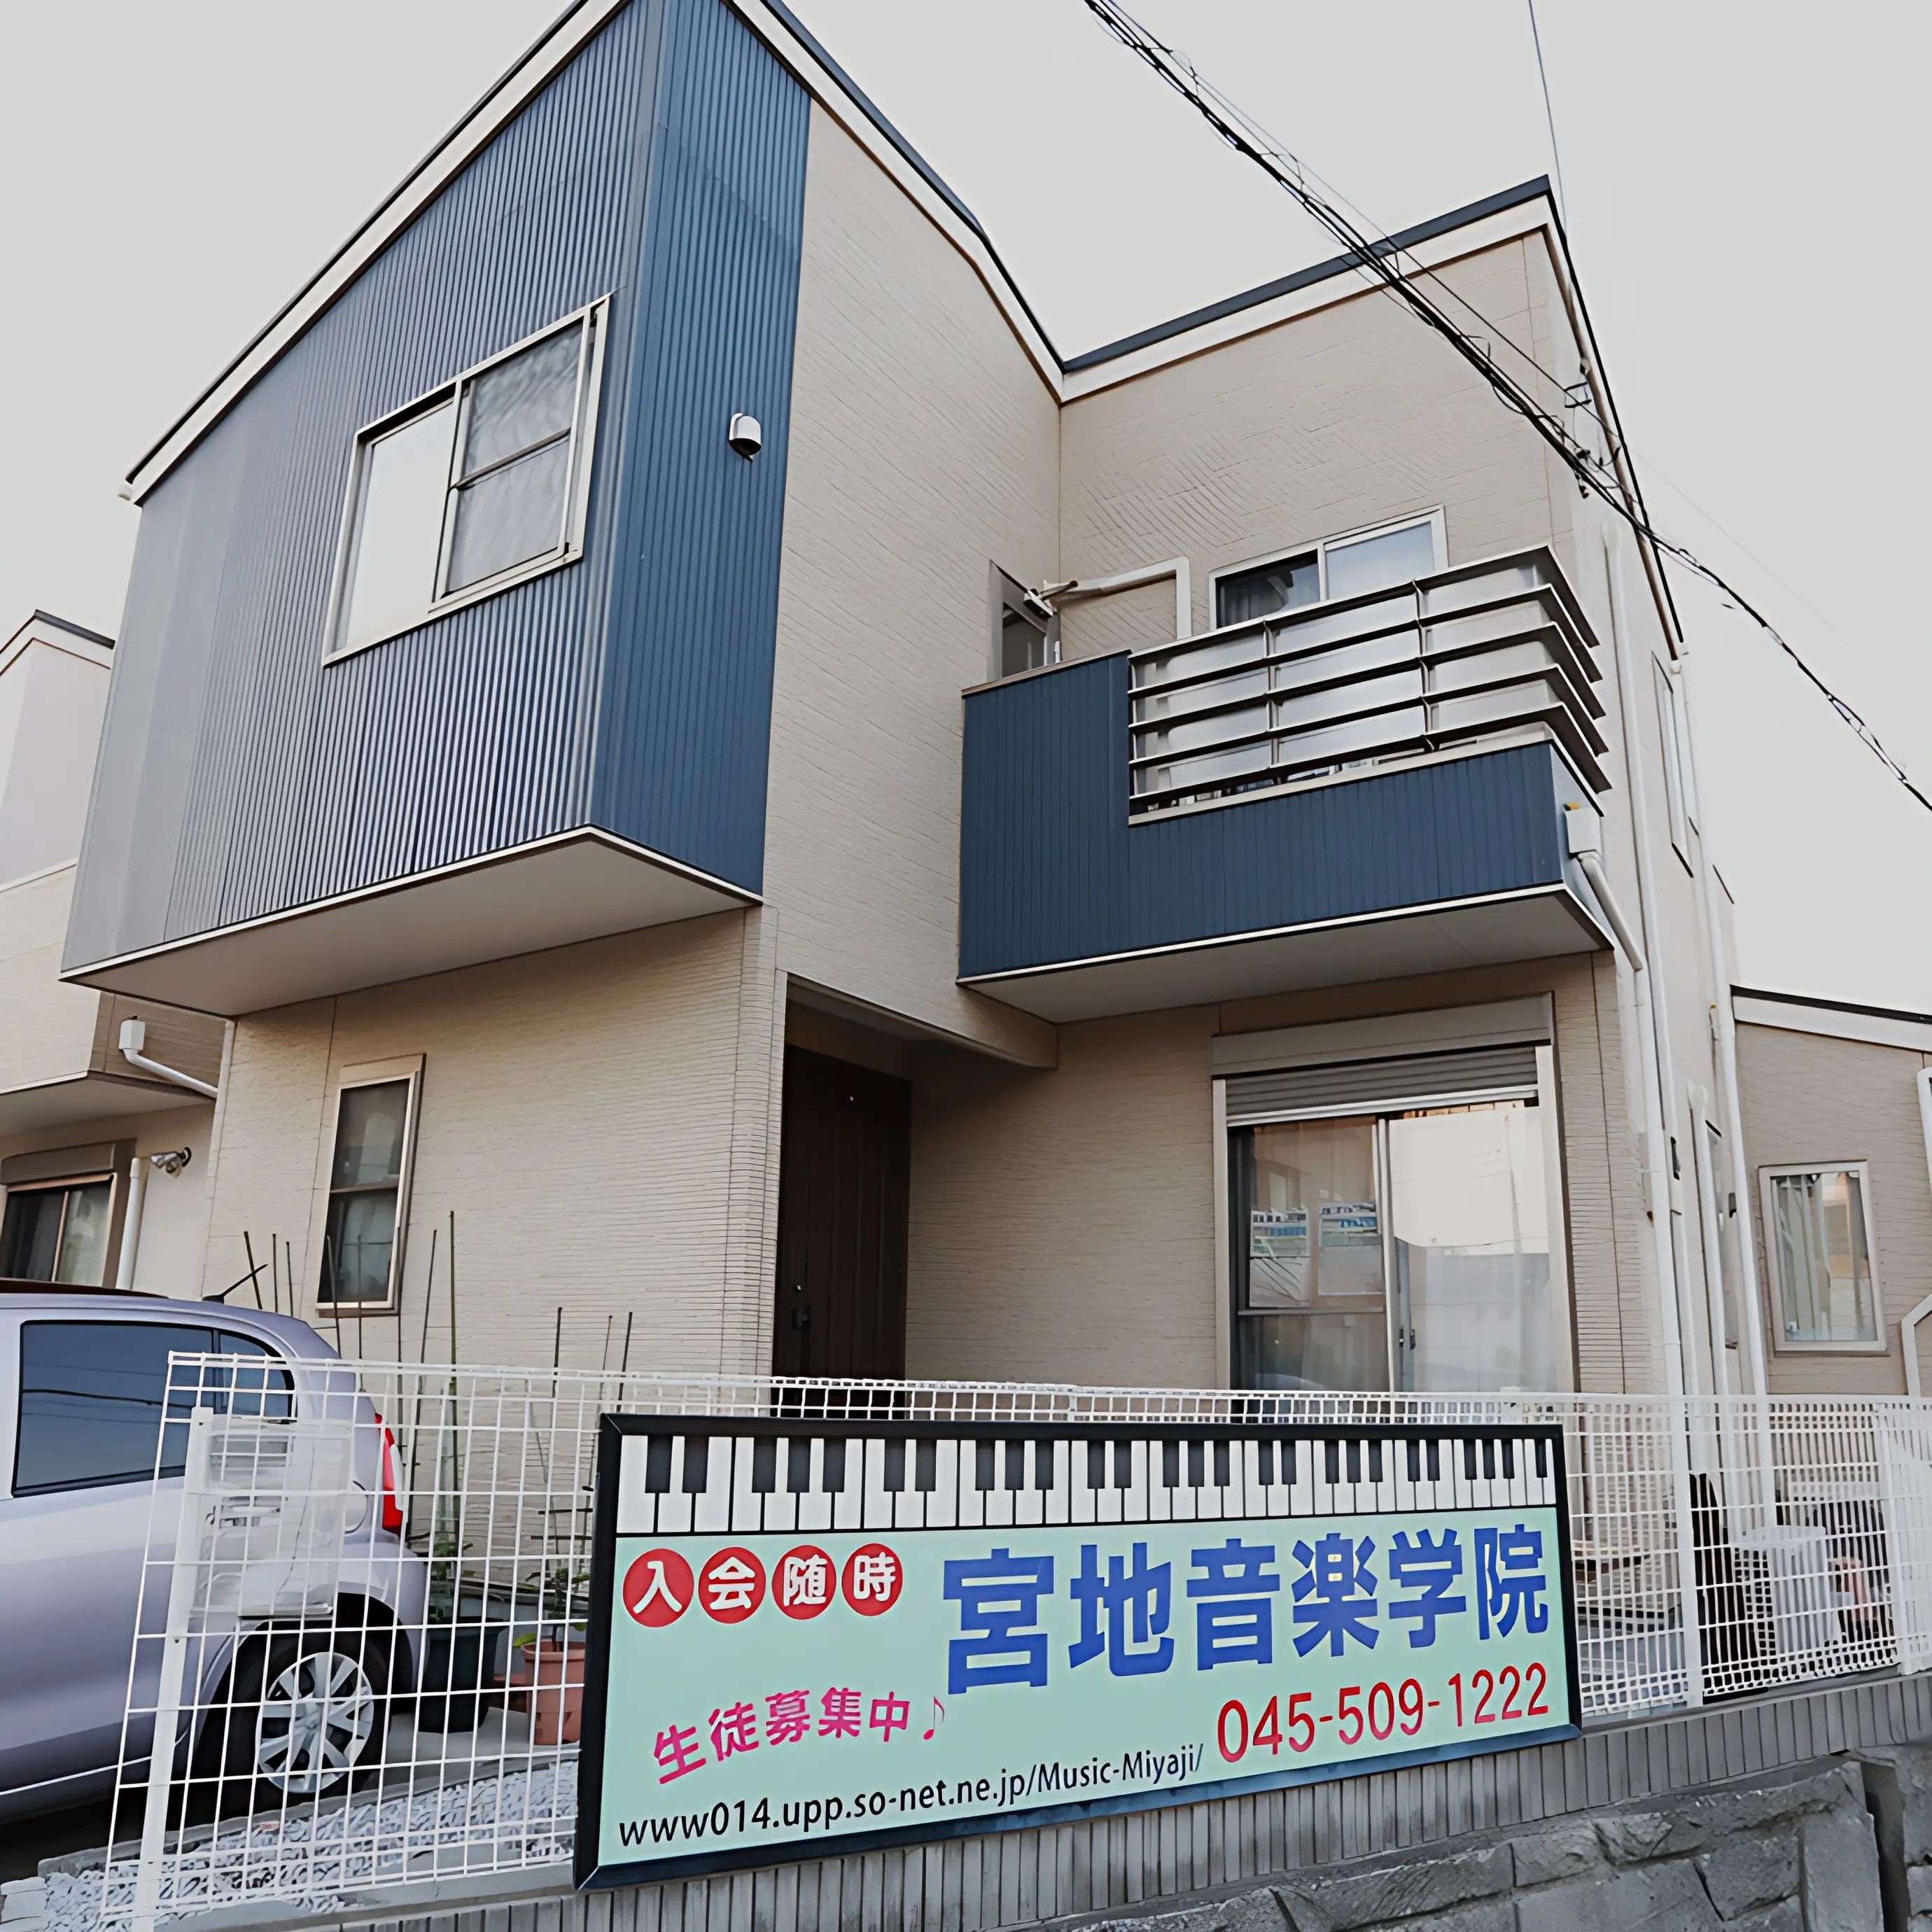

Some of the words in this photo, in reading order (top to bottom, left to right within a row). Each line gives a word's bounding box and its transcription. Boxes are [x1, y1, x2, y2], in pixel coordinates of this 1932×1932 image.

[632, 1551, 897, 1614] 入会随時
[943, 1524, 1548, 1695] 宮地音楽学院
[653, 1687, 910, 1784] 生徒募集中
[1217, 1662, 1549, 1763] 045-509-1222
[619, 1743, 1204, 1847] www014.upp.so-net.ne.jp/Music-Miyaji/
